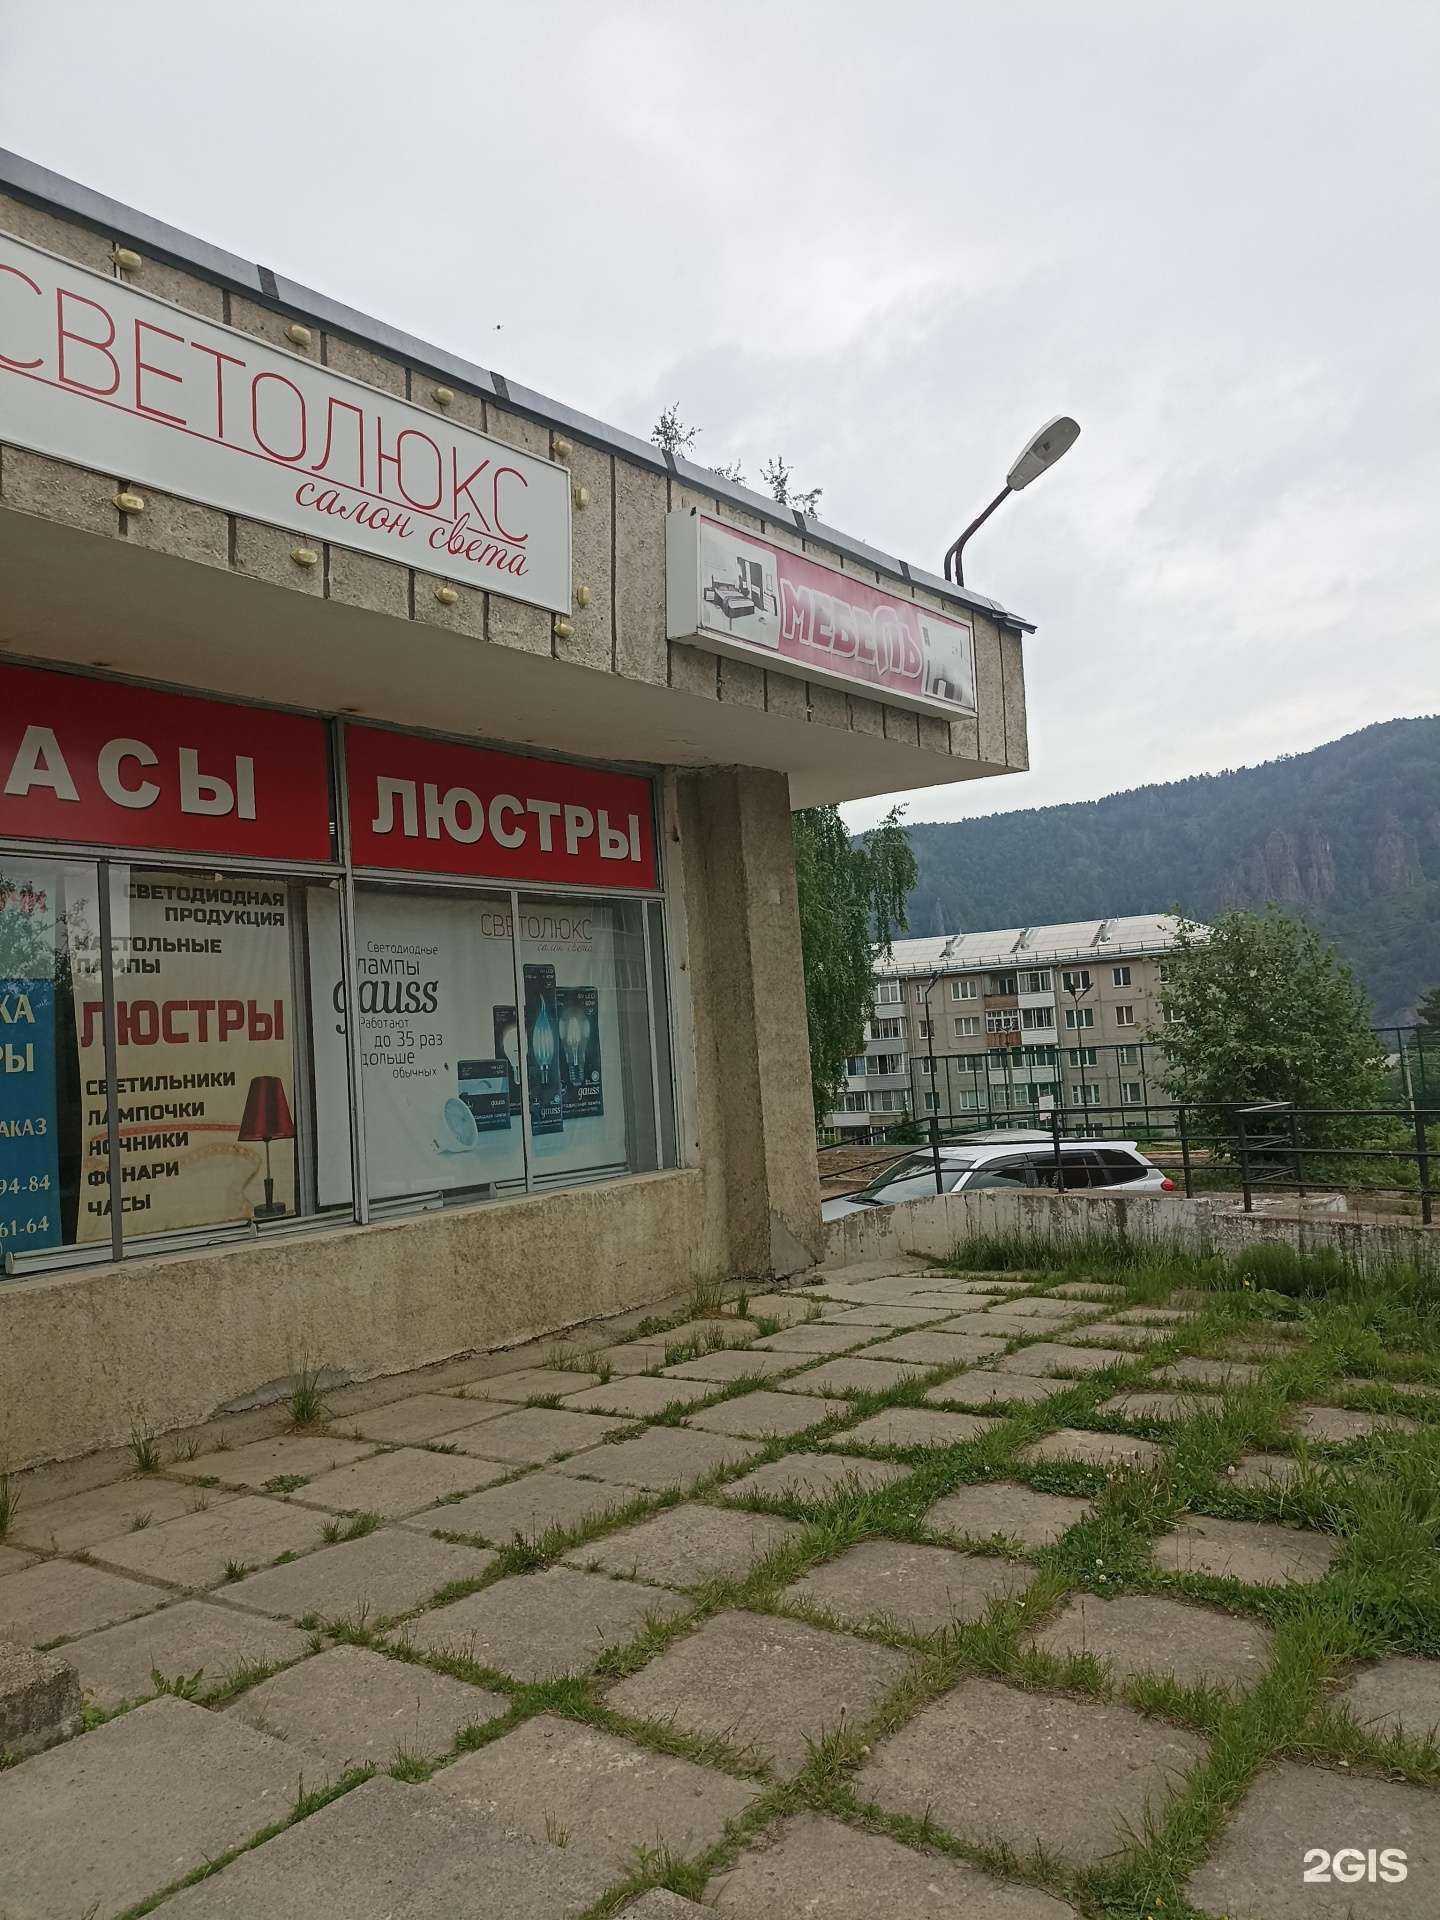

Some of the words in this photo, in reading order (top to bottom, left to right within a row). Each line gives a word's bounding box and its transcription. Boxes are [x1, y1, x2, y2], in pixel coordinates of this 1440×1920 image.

[0, 264, 528, 542] СВЕТОЛЮКС
[295, 481, 414, 538] салон
[428, 512, 529, 577] света
[780, 577, 924, 679] МЕБЕЛЬ
[4, 724, 257, 820] АСЫ
[371, 775, 641, 863] ЛЮСТРЫ
[124, 883, 285, 907] СВЕТОДИОДНАЯ
[165, 907, 285, 927] ПРОДУКЦИЯ
[367, 941, 439, 956] Светодиодные
[357, 957, 420, 976] лампы
[80, 1000, 284, 1048] ЛЮСТРЫ
[360, 1016, 409, 1029] Работают
[374, 1035, 391, 1048] до
[397, 1031, 415, 1047] 35
[419, 1034, 443, 1049] раз
[362, 1051, 415, 1067] дольше
[392, 1067, 437, 1079] обычных
